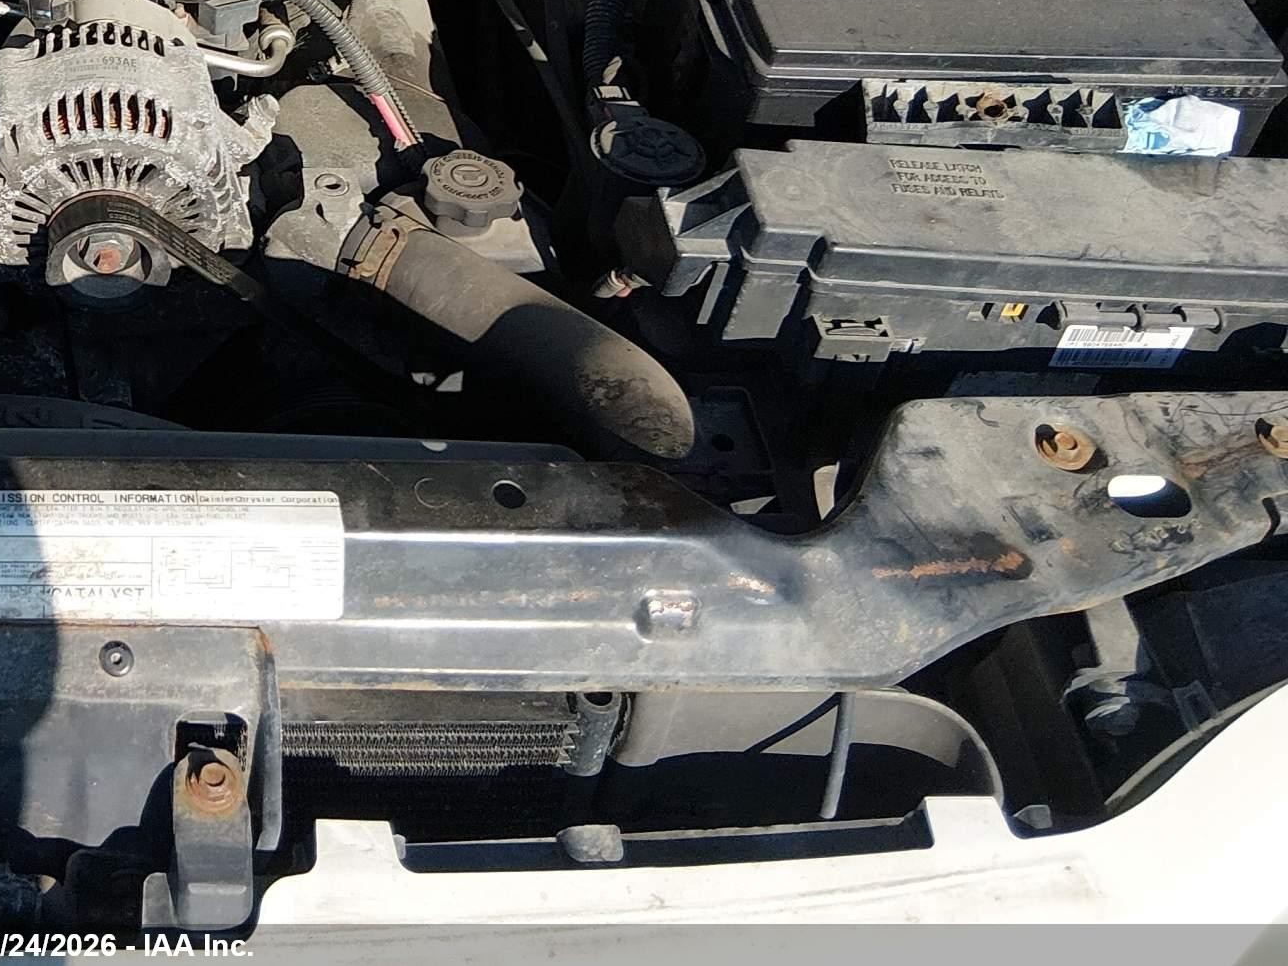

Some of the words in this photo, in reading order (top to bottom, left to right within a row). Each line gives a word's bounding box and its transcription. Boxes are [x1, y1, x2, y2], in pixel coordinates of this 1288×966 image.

[889, 159, 942, 171] RELEASE
[896, 171, 921, 183] FOR
[924, 174, 969, 185] ACCESS
[969, 175, 987, 186] TO
[891, 183, 931, 194] FUSES
[933, 185, 957, 196] AND
[958, 187, 1005, 199] RELAYS
[52, 493, 104, 503] CONTROL
[114, 493, 195, 503] INFORMATION
[199, 495, 275, 504] DaimlerChrysler
[280, 495, 339, 505] Corporation
